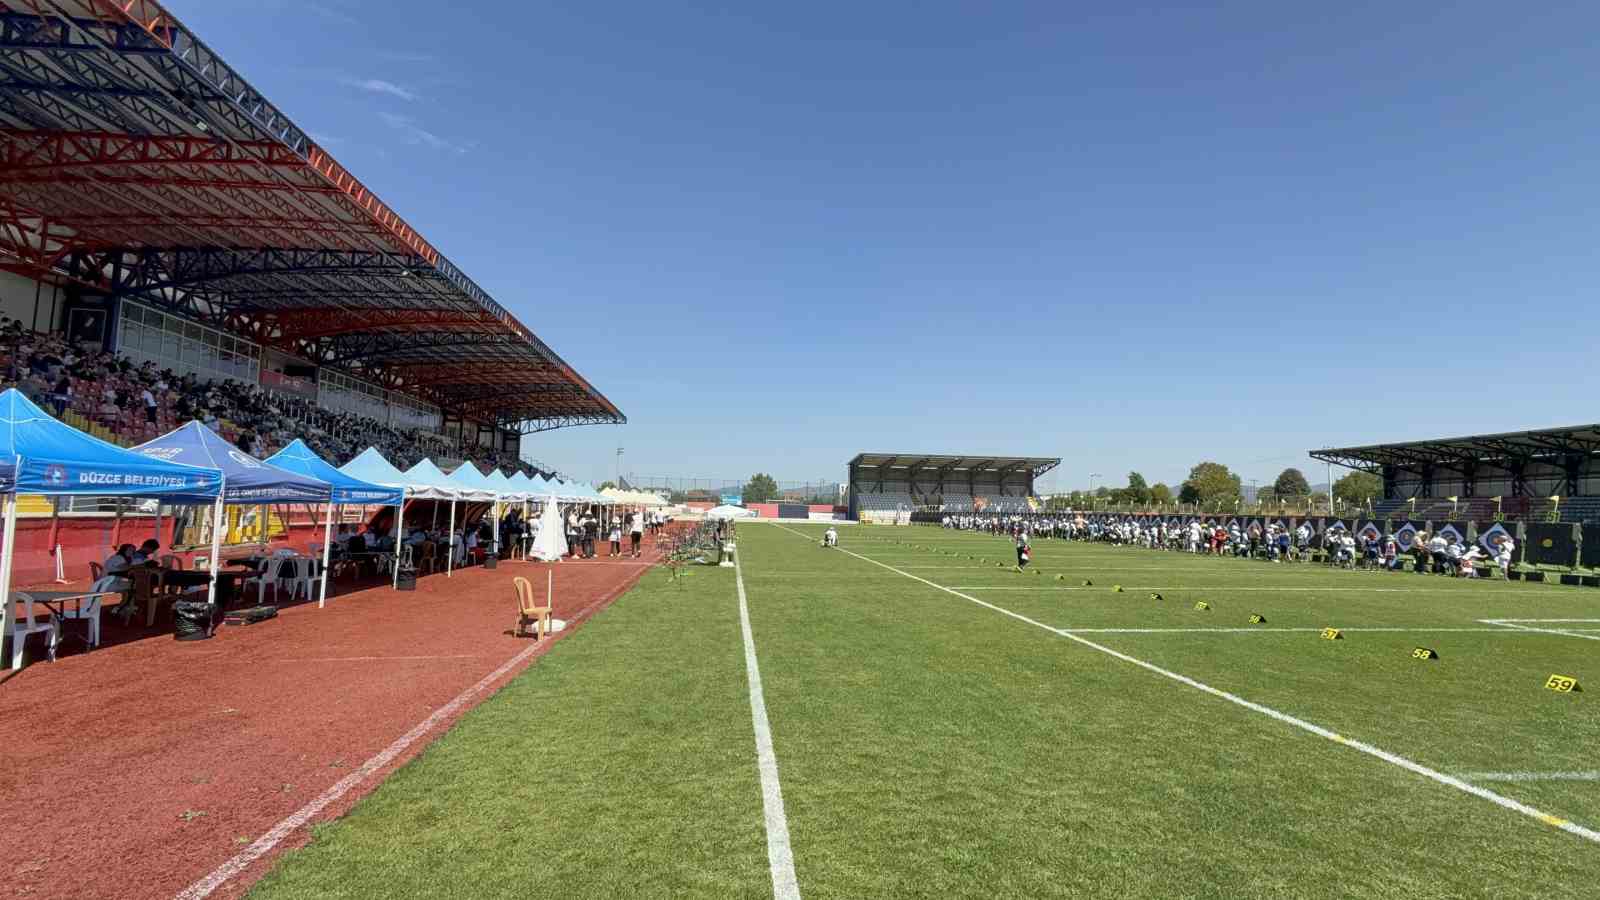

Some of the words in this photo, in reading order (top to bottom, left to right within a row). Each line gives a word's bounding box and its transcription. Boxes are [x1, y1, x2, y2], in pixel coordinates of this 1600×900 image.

[79, 472, 121, 484] DÜZCE
[124, 475, 185, 487] BELEDİYESİ
[1412, 648, 1431, 660] 58
[1548, 678, 1573, 692] 59
